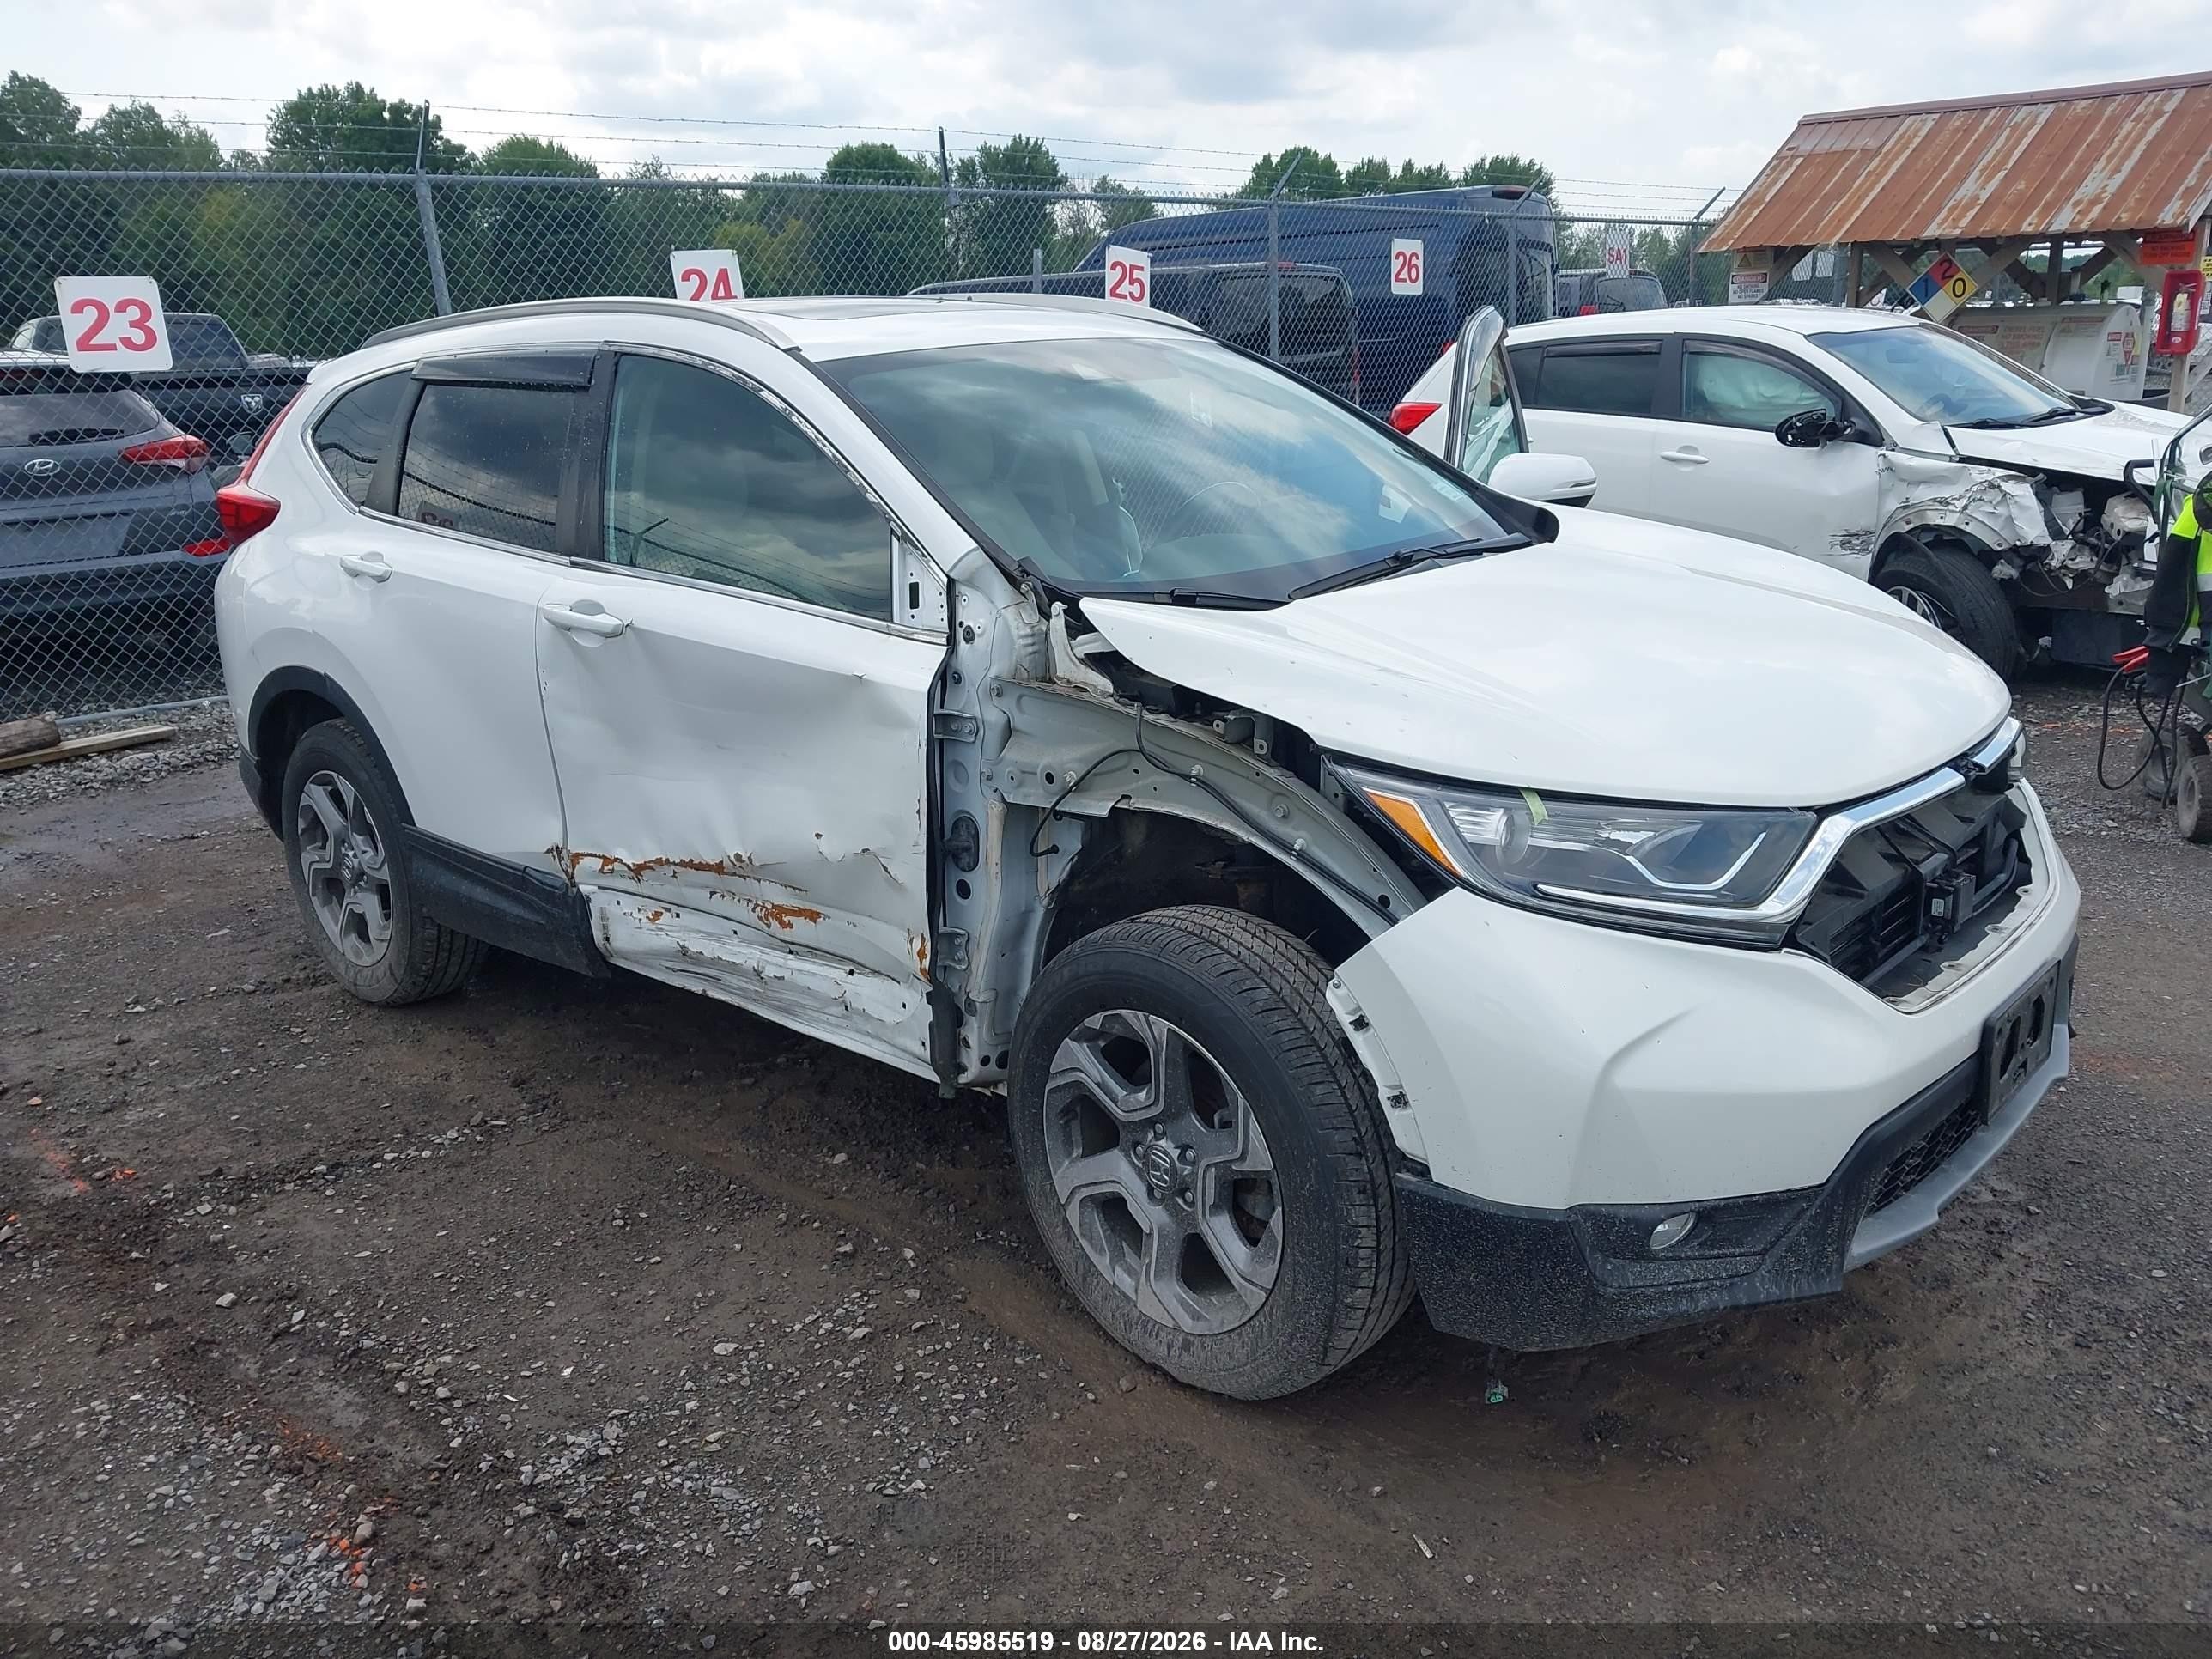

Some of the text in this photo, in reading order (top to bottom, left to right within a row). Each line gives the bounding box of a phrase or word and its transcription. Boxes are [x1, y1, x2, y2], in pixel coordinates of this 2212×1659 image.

[1393, 251, 1420, 284] 26
[1607, 247, 1627, 264] SA1
[1109, 260, 1146, 303] 25
[1939, 259, 1954, 280] 2
[681, 268, 738, 301] 24
[1923, 278, 1929, 297] 1
[1952, 277, 1966, 298] 0
[70, 298, 158, 352] 23
